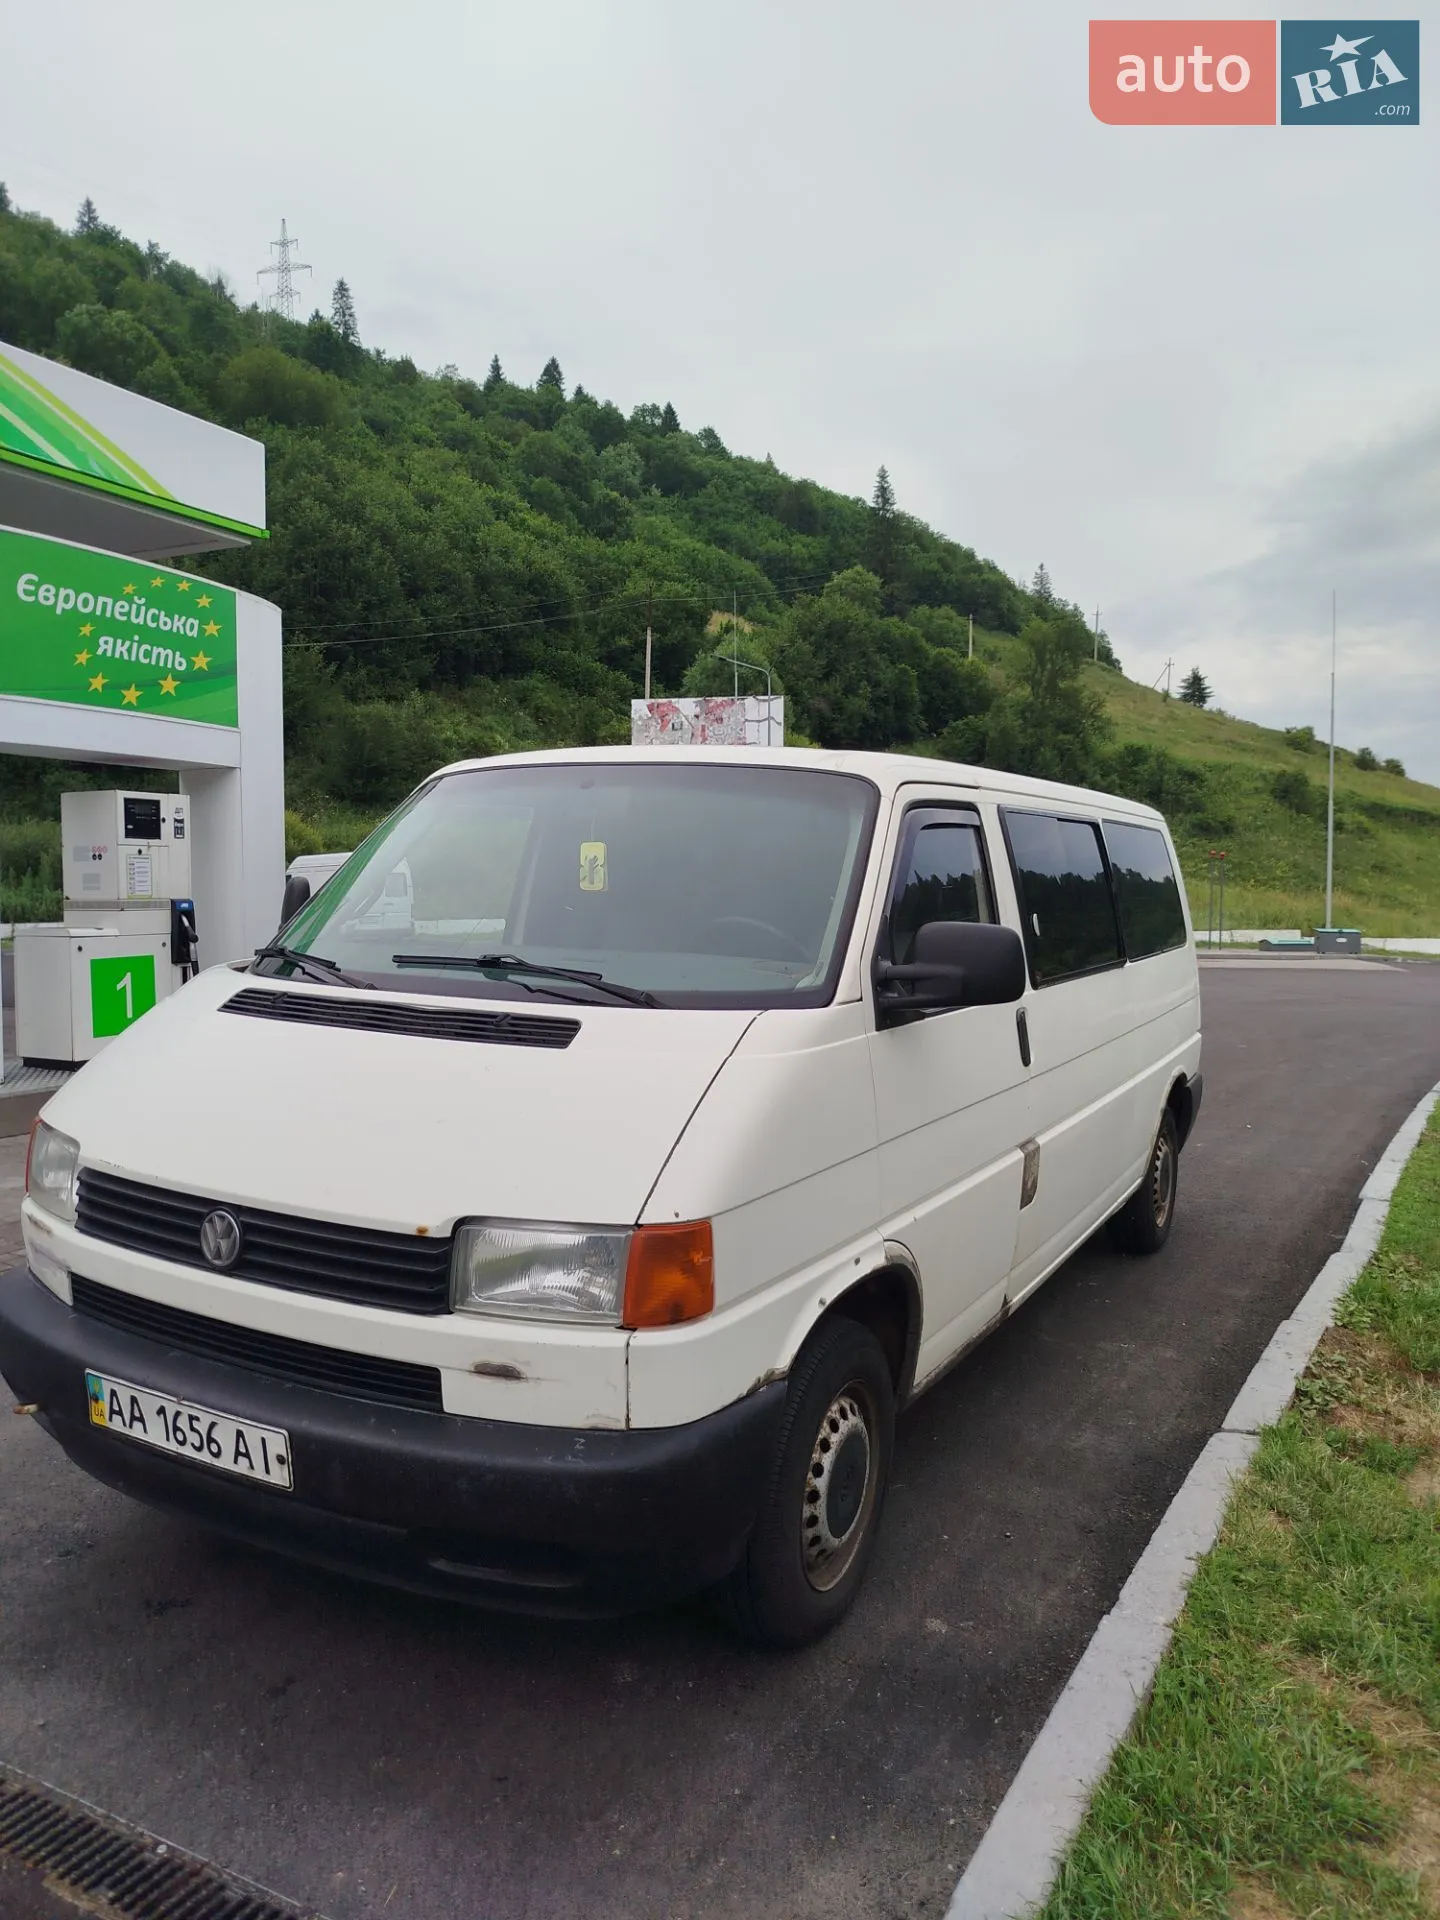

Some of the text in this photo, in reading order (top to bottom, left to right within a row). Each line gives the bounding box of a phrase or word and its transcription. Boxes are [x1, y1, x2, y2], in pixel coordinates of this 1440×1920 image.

[17, 573, 199, 637] Європейська
[96, 634, 187, 671] якість
[116, 971, 133, 1019] 1
[93, 1407, 105, 1420] UA
[108, 1388, 271, 1476] AA 1656 AI
